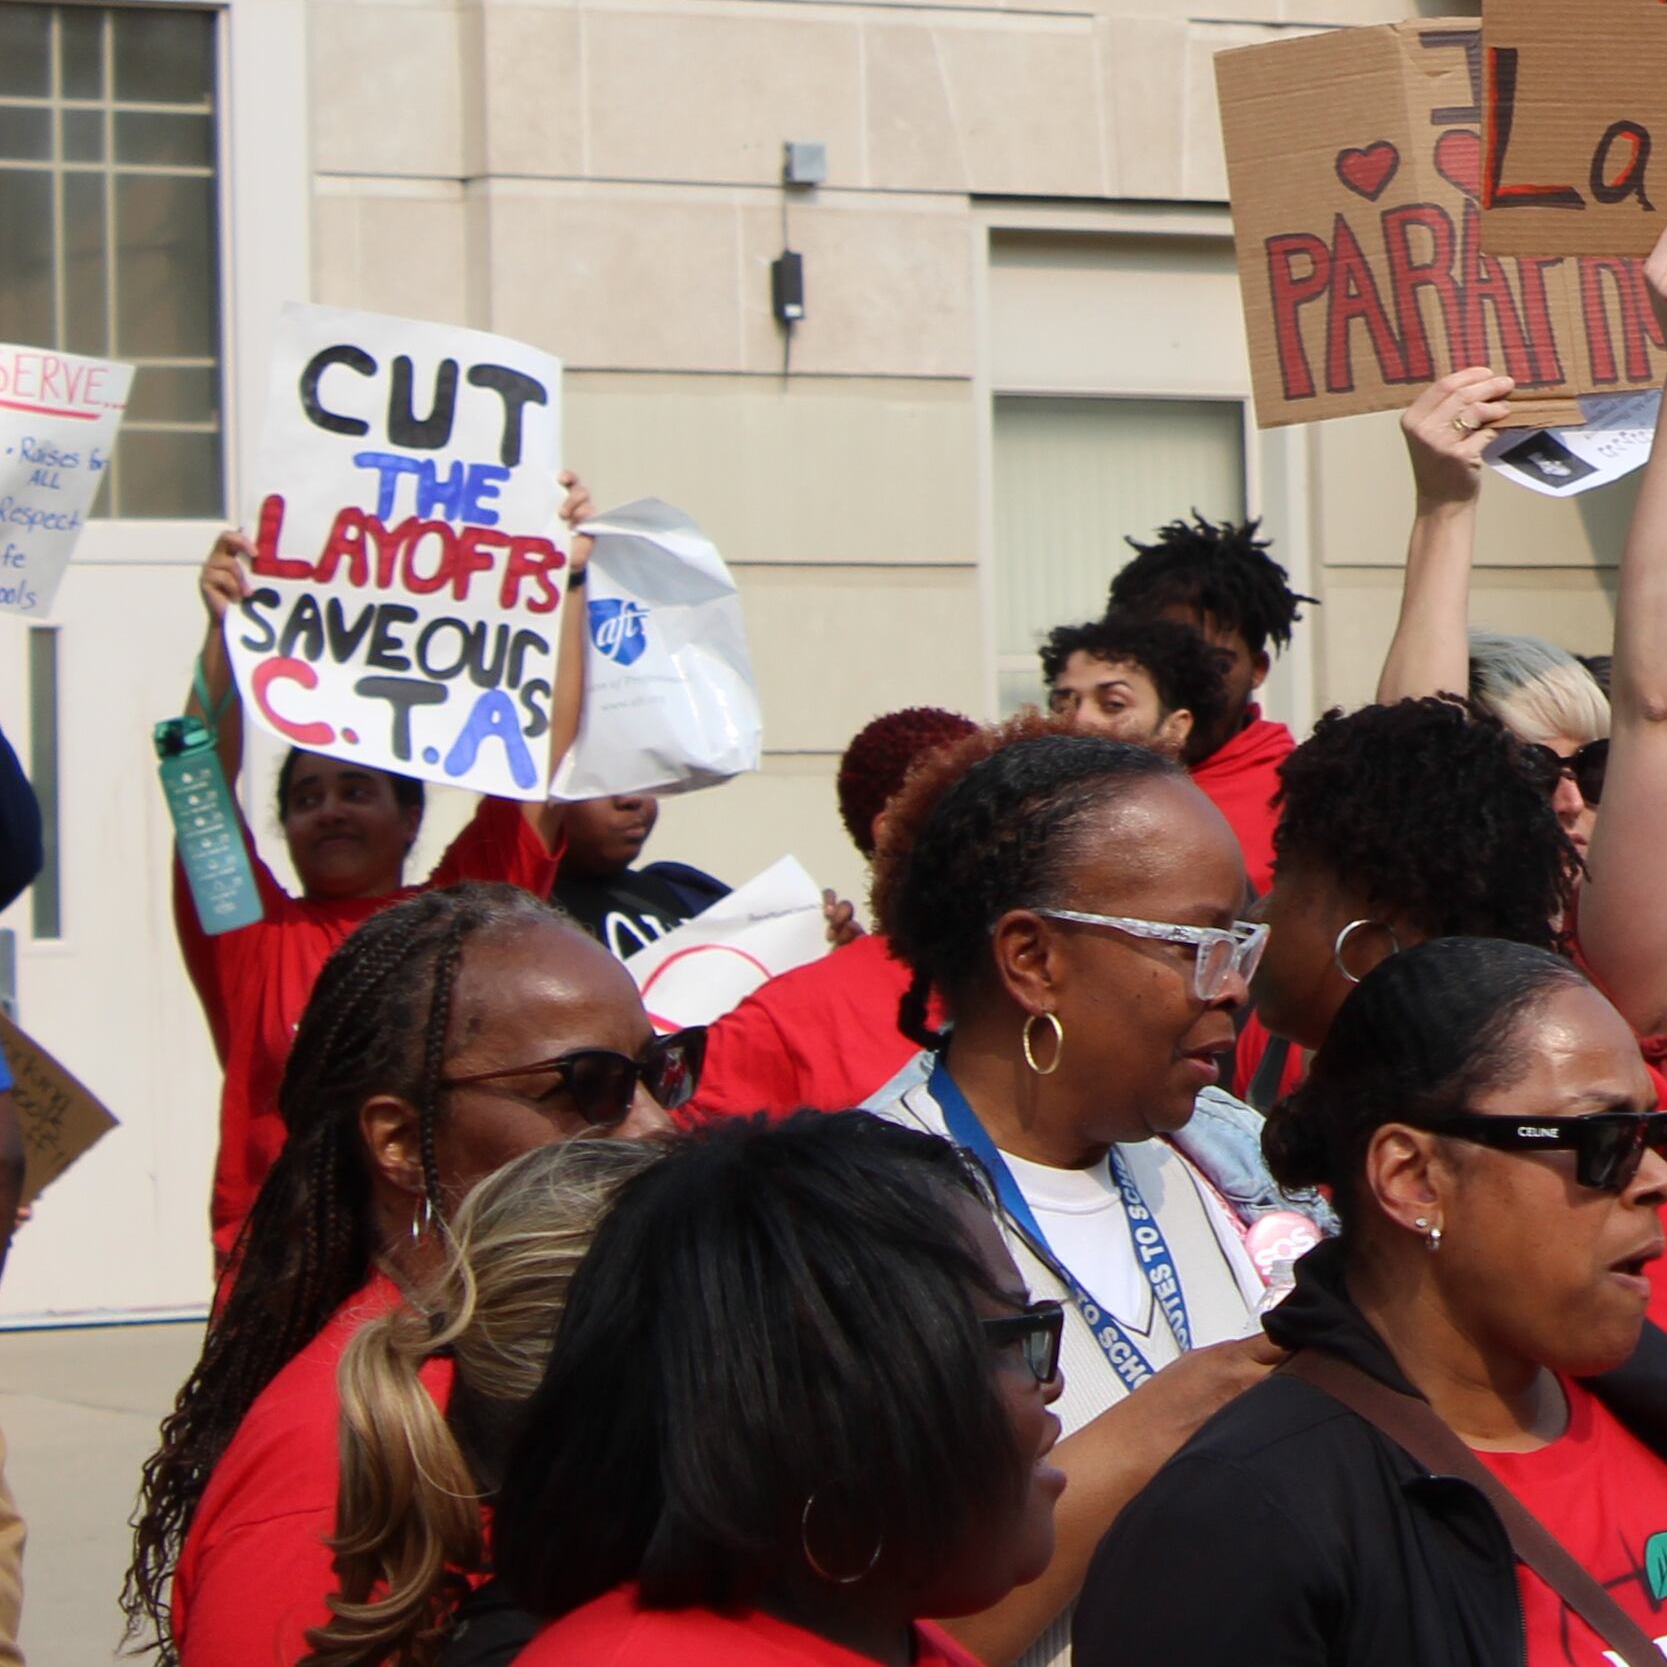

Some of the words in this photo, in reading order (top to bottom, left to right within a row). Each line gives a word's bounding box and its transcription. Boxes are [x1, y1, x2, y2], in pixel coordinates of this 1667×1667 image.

[300, 345, 548, 468] CUT
[353, 451, 511, 526] THE
[241, 588, 418, 673] SAVE
[1516, 1126, 1559, 1138] CELINE
[1134, 1226, 1165, 1263] TO
